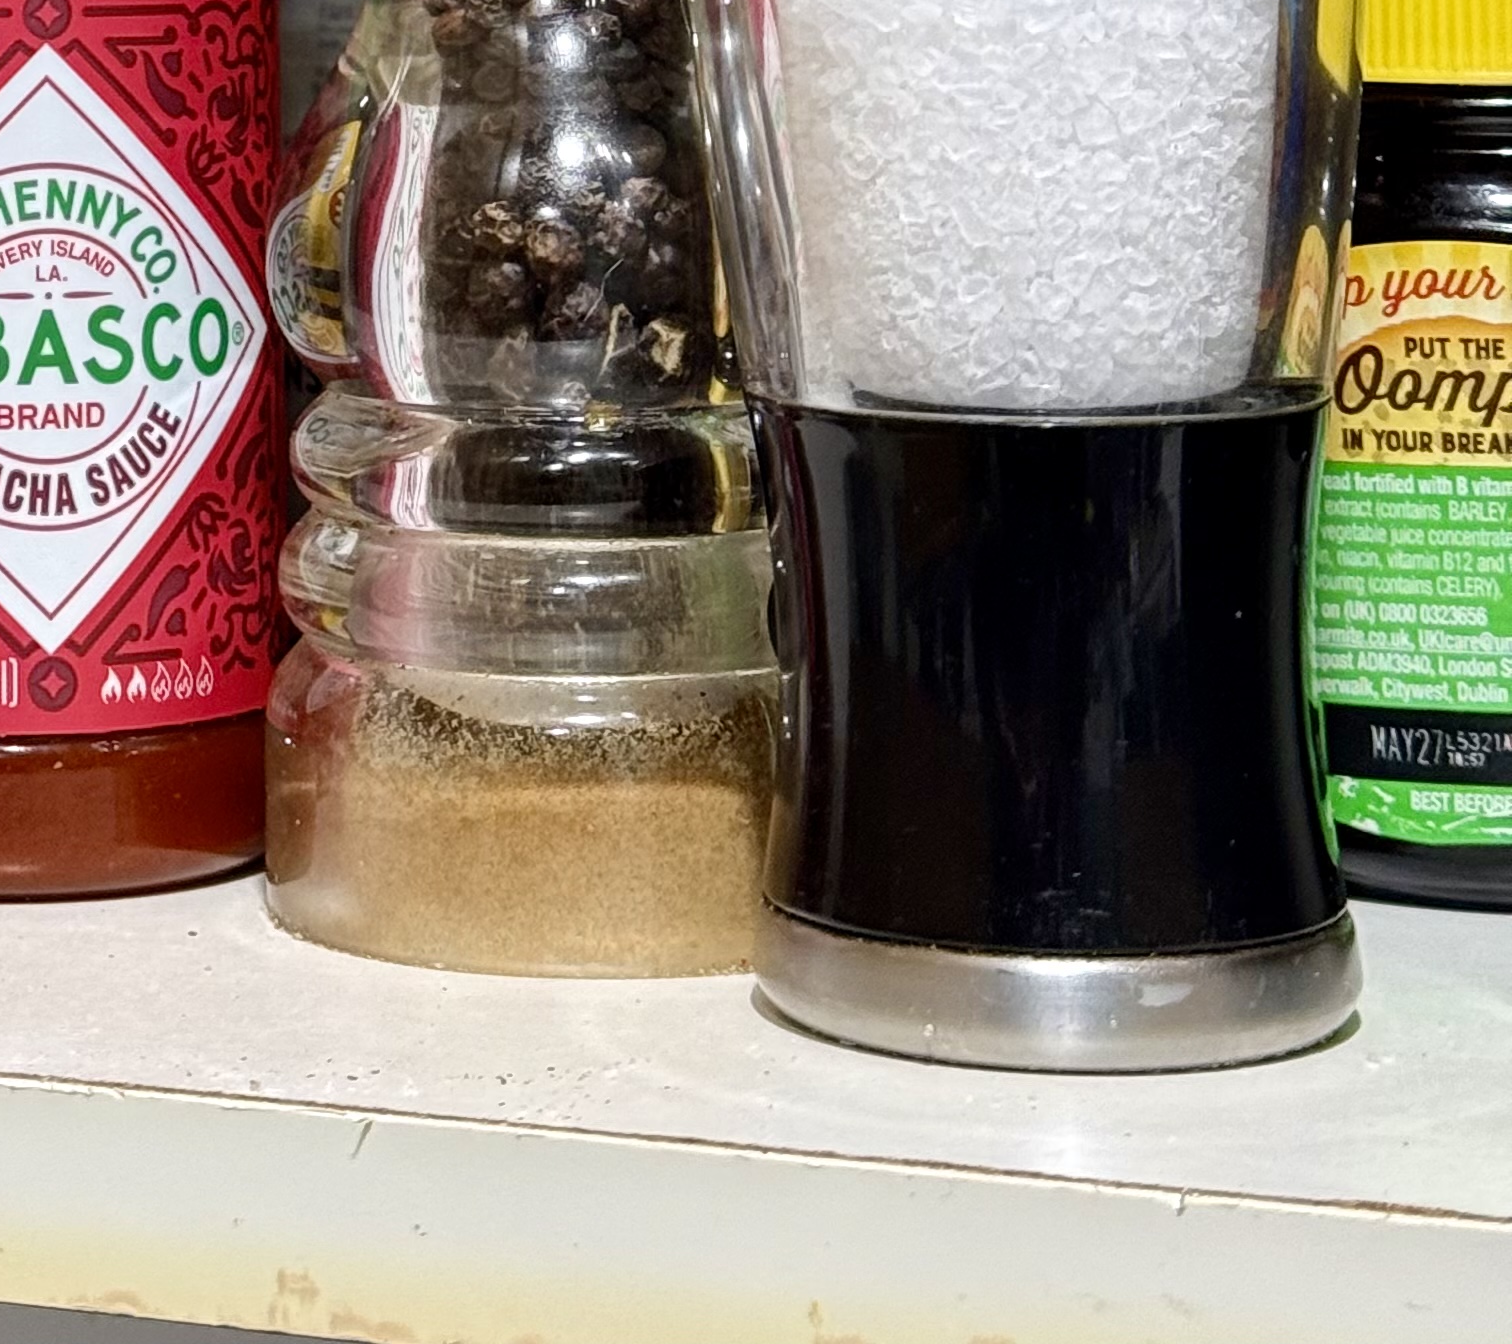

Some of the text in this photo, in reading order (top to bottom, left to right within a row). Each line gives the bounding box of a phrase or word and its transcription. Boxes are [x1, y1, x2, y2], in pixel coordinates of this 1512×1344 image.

[50, 238, 116, 278] ISLAND
[130, 225, 178, 294] CO.
[35, 264, 68, 282] LA.
[1382, 265, 1505, 318] your
[1404, 336, 1506, 360] PUT THE
[1342, 427, 1363, 450] IN
[1371, 428, 1433, 454] YOUR
[87, 402, 183, 507] SAUCE
[1442, 551, 1474, 572] B12
[1477, 554, 1505, 573] and
[1438, 656, 1498, 677] London
[1456, 681, 1509, 703] Dublin
[1410, 790, 1451, 813] BEST
